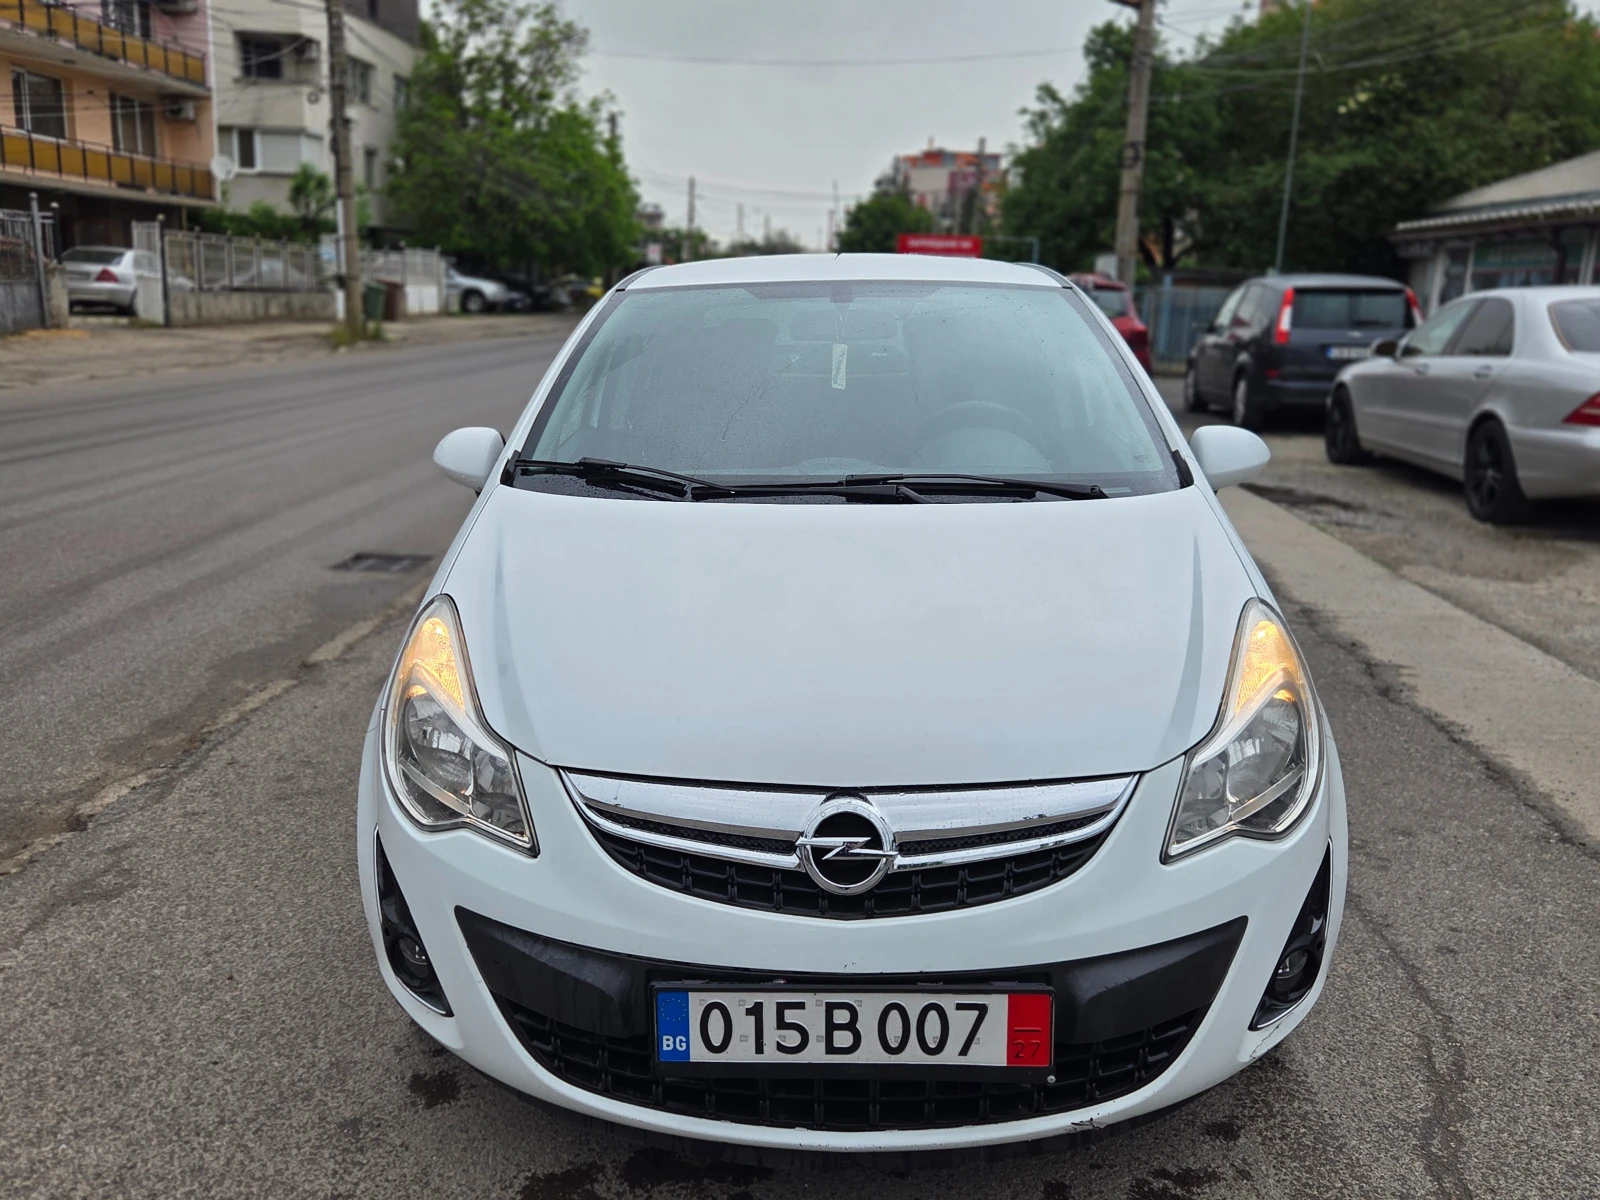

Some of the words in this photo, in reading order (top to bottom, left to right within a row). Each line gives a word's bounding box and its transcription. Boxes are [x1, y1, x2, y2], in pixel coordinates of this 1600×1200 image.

[820, 806, 872, 819] OPEL
[662, 1035, 687, 1051] BG
[1013, 1039, 1041, 1058] 27
